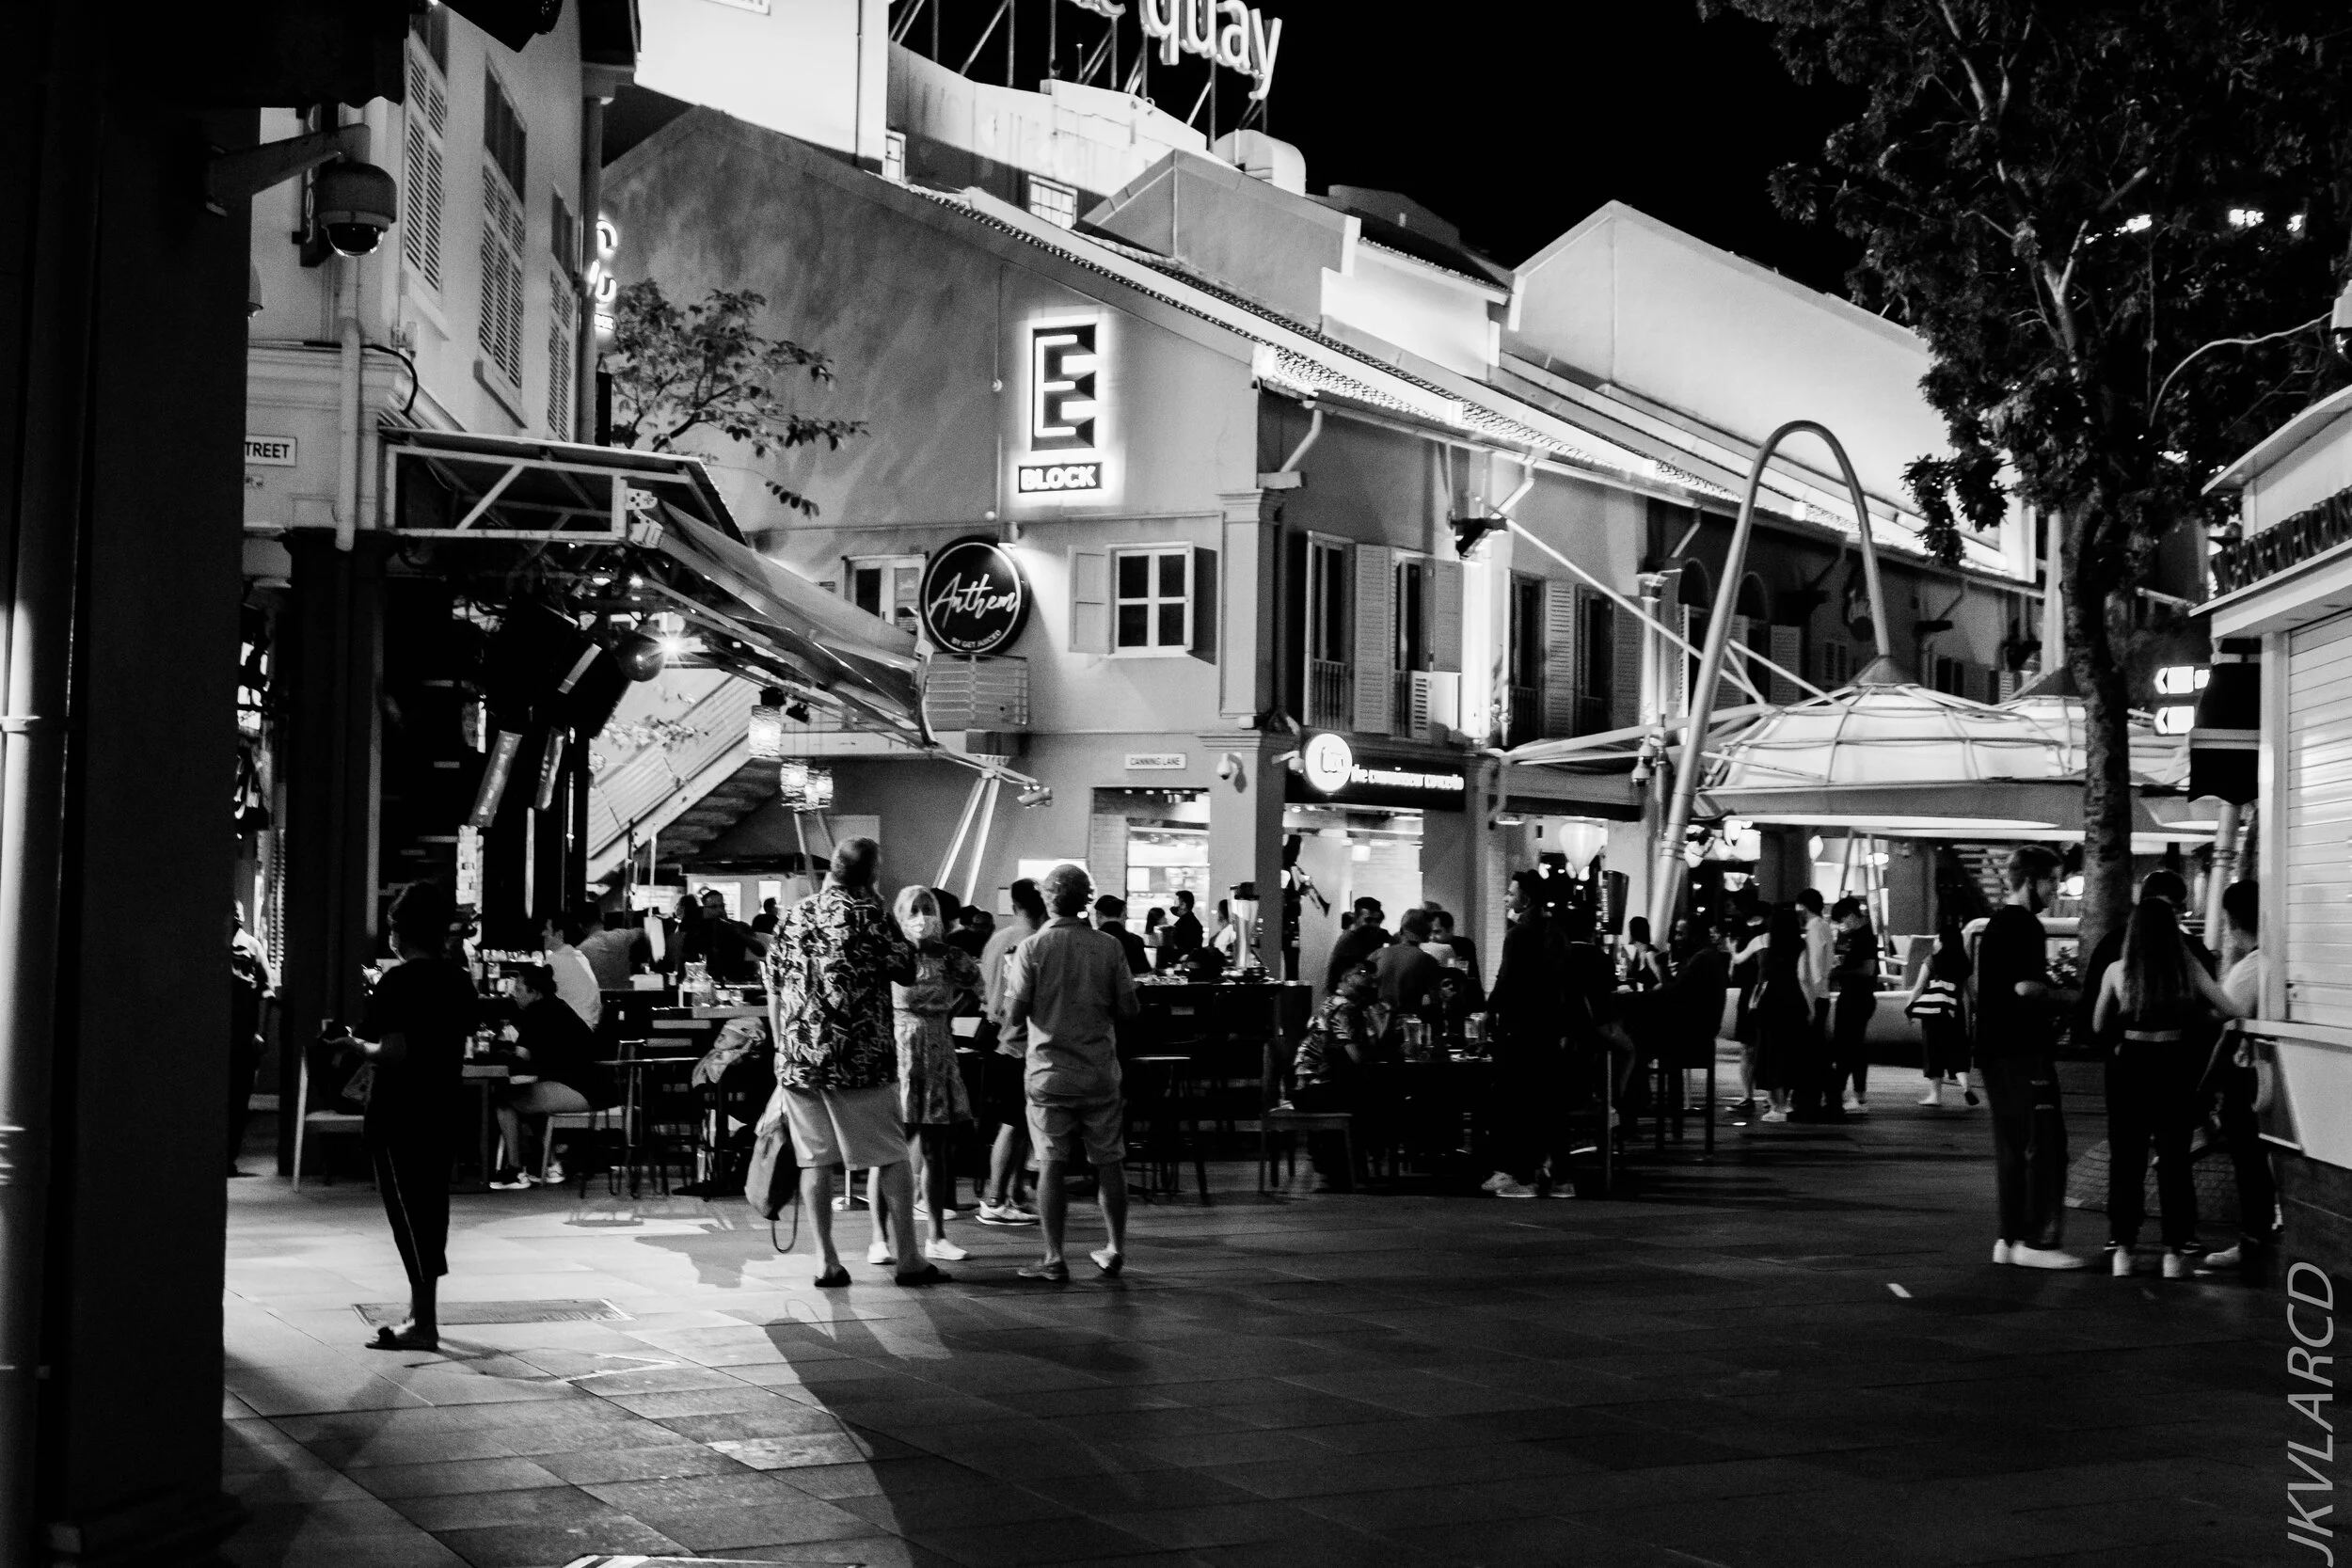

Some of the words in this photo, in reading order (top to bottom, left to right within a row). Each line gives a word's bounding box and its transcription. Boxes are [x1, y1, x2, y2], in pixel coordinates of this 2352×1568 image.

[1138, 0, 1282, 100] quay
[1032, 324, 1097, 451] E
[245, 441, 290, 459] TREET
[1020, 465, 1097, 491] BLOCK
[930, 572, 1018, 628] Anthem
[1163, 756, 1181, 766] LANE
